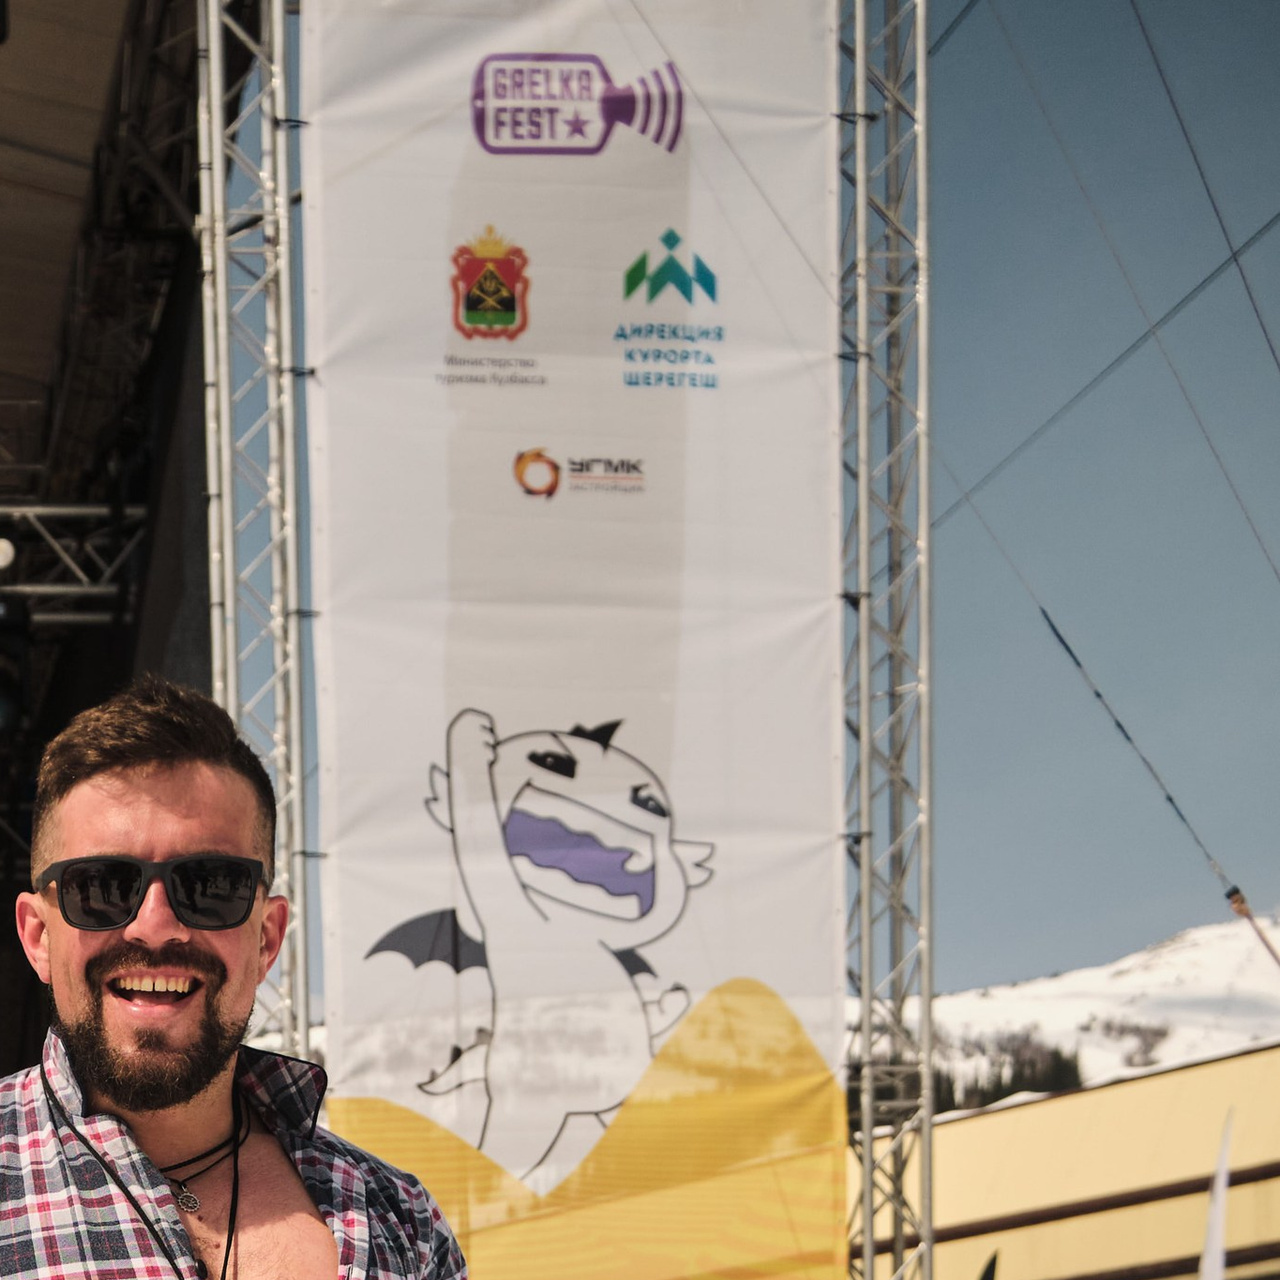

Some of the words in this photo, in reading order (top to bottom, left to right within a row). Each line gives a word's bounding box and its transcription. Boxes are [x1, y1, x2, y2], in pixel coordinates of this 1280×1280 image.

[492, 66, 592, 101] GRELKA
[493, 107, 560, 140] FEST
[614, 323, 725, 342] ДИРЕКЦИЯ
[624, 348, 716, 365] КУРОРТА
[623, 371, 719, 389] ШЕРЕГЕШ
[568, 457, 643, 475] УГМК
